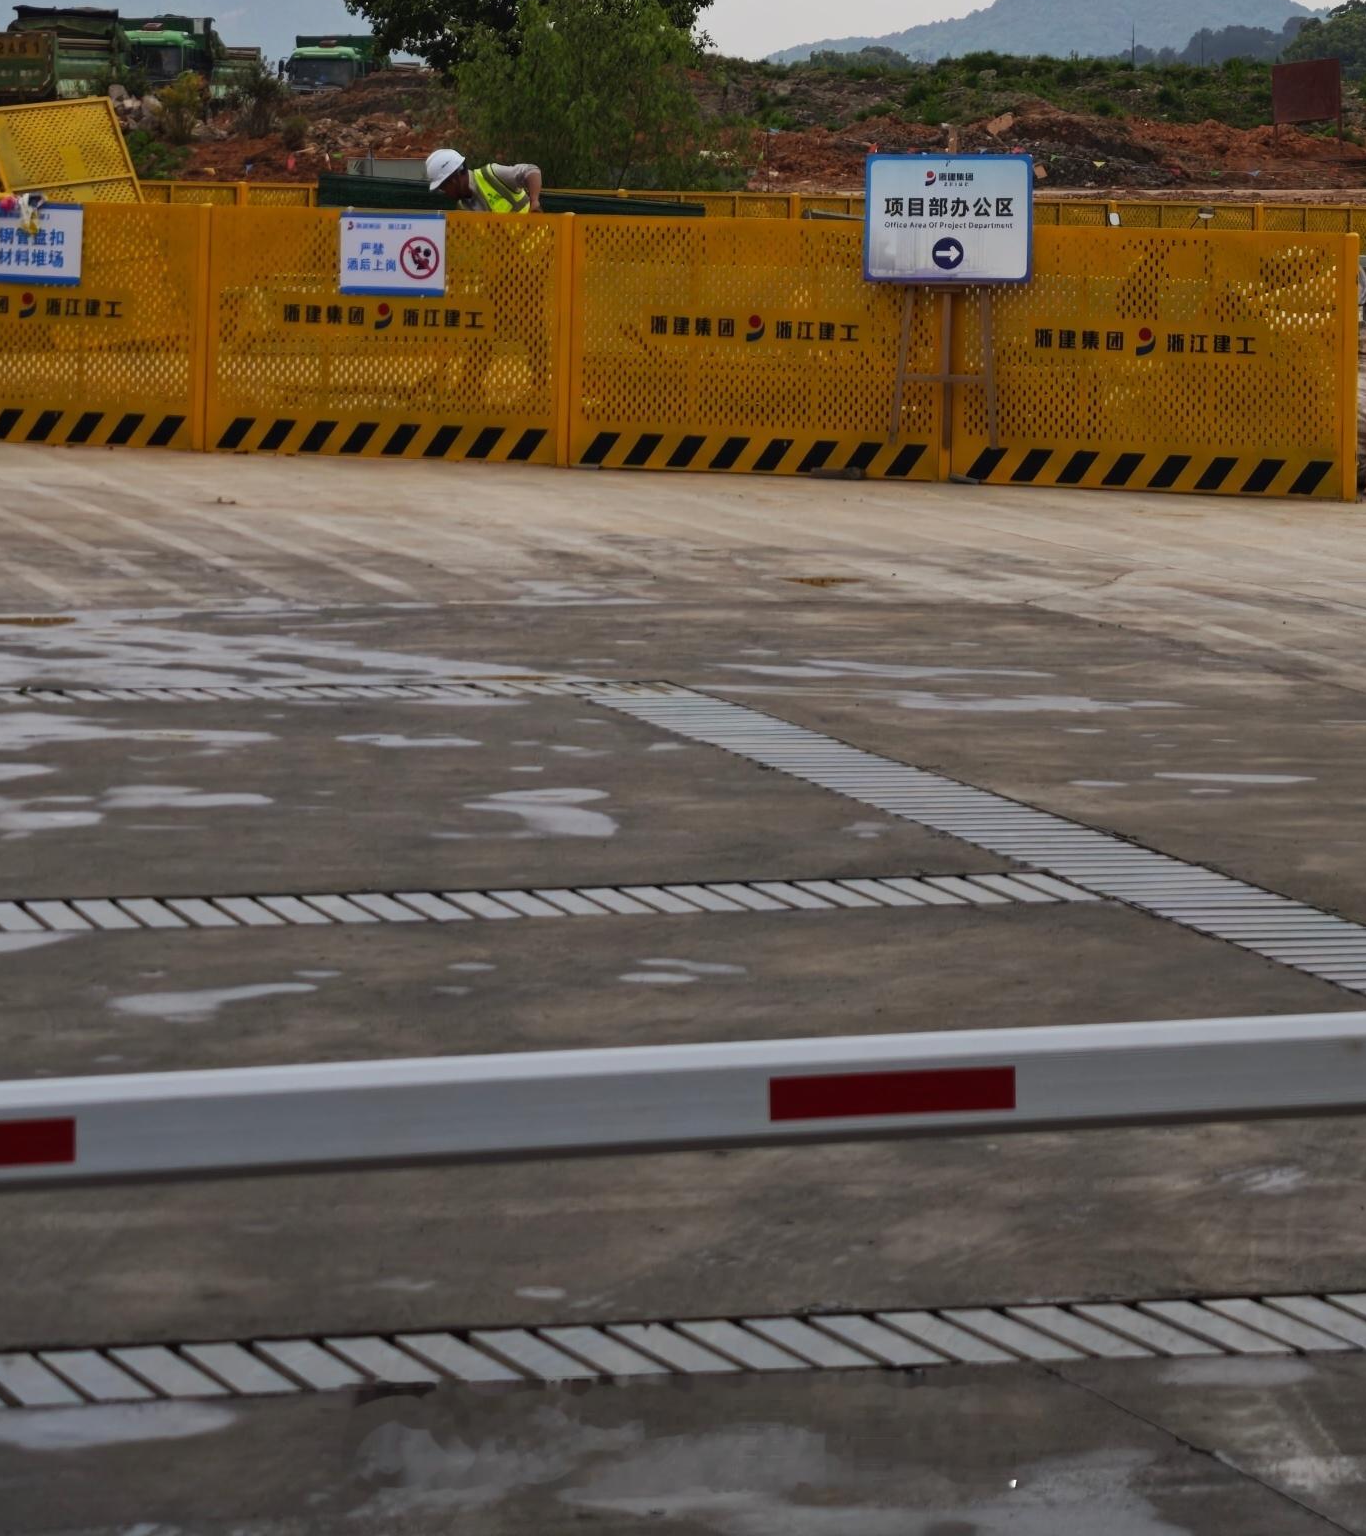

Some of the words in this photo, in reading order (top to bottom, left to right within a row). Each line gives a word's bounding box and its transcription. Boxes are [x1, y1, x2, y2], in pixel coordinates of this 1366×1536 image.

[884, 197, 1014, 217] 项目部办公区
[884, 221, 908, 229] Office
[939, 222, 966, 231] Project
[968, 222, 1013, 231] Department
[359, 242, 385, 256] 严禁
[347, 257, 397, 272] 酒后上岗
[46, 297, 123, 319] 浙江建工
[283, 304, 365, 325] 浙建集团
[403, 309, 485, 329] 浙江建工
[650, 314, 735, 337] 浙建集团
[776, 319, 859, 342] 浙江建工
[1034, 327, 1124, 352] 浙建集团
[1167, 332, 1257, 355] 浙江建工
